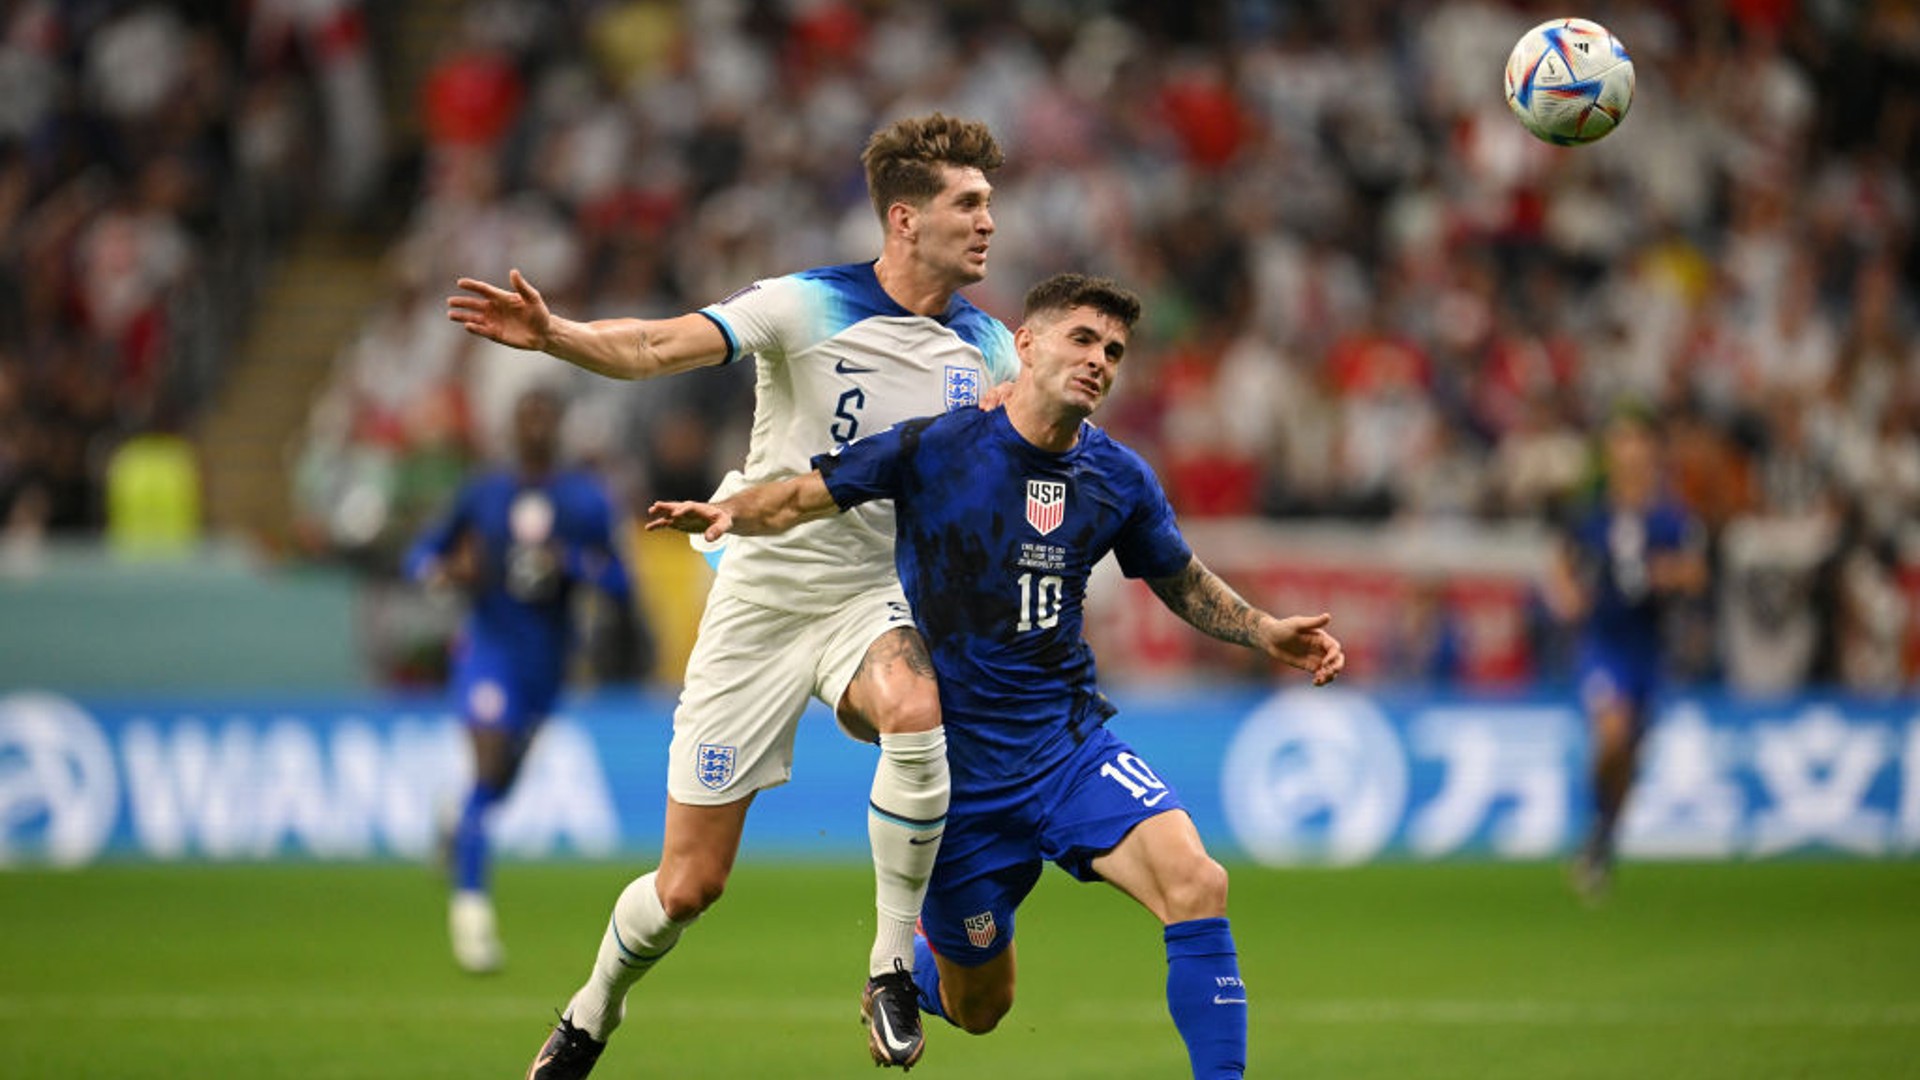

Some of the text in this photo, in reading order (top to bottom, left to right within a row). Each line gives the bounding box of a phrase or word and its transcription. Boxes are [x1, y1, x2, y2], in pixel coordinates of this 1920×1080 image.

[1028, 482, 1064, 504] USA
[1017, 573, 1063, 632] 10
[1100, 752, 1167, 800] 10
[965, 914, 992, 931] USA
